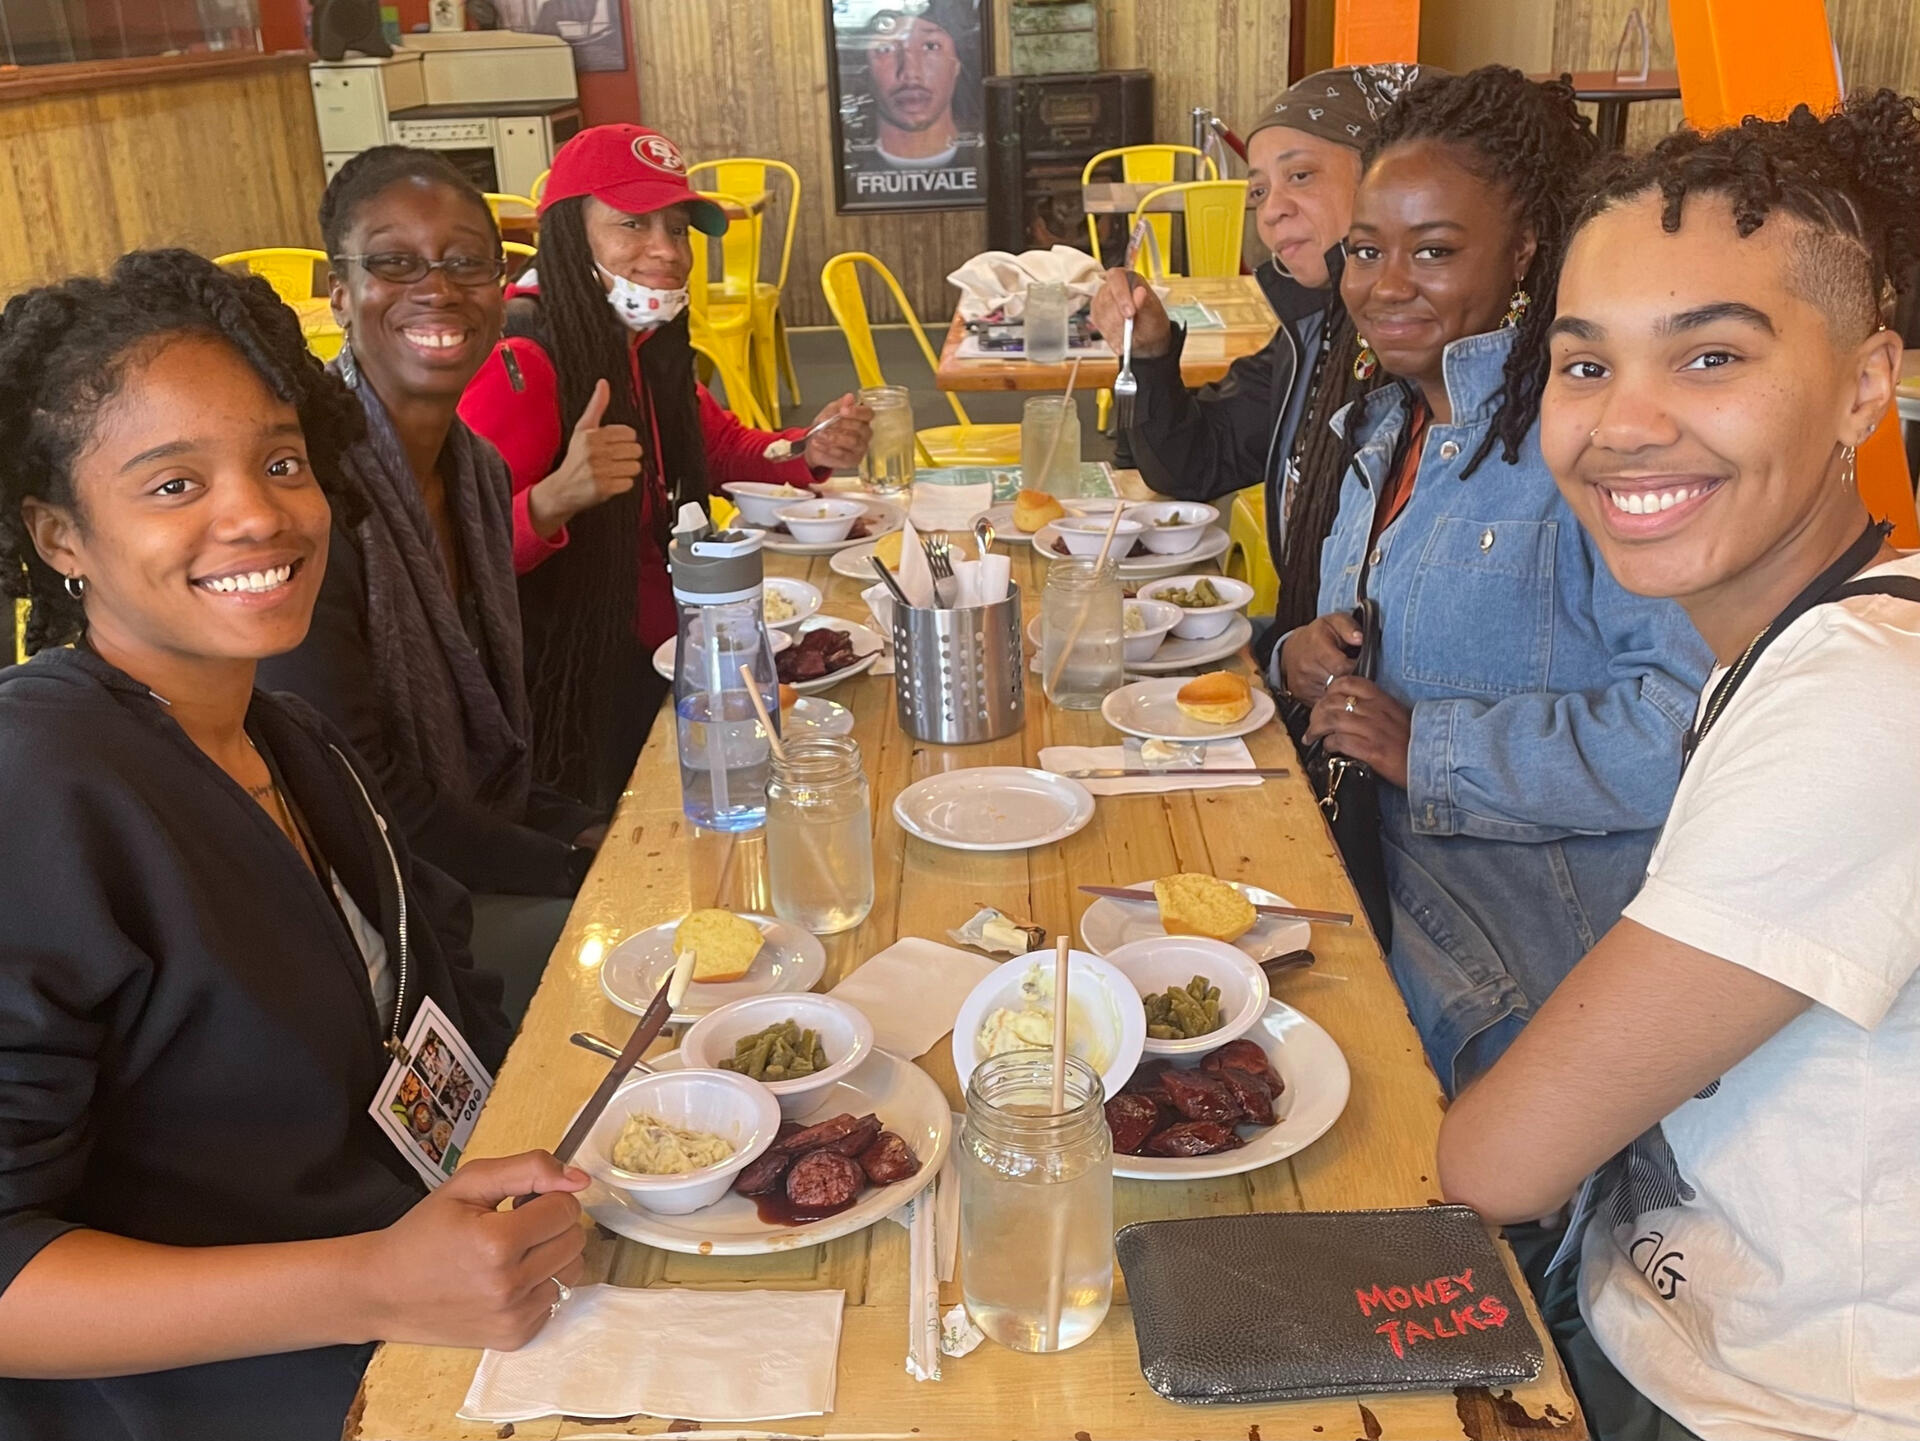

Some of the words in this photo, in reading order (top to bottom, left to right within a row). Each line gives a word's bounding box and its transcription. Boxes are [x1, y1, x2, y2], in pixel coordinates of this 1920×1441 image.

[856, 171, 978, 194] FRUITVALE
[1355, 1268, 1474, 1317] MONEY
[1375, 1296, 1509, 1359] TALKS
